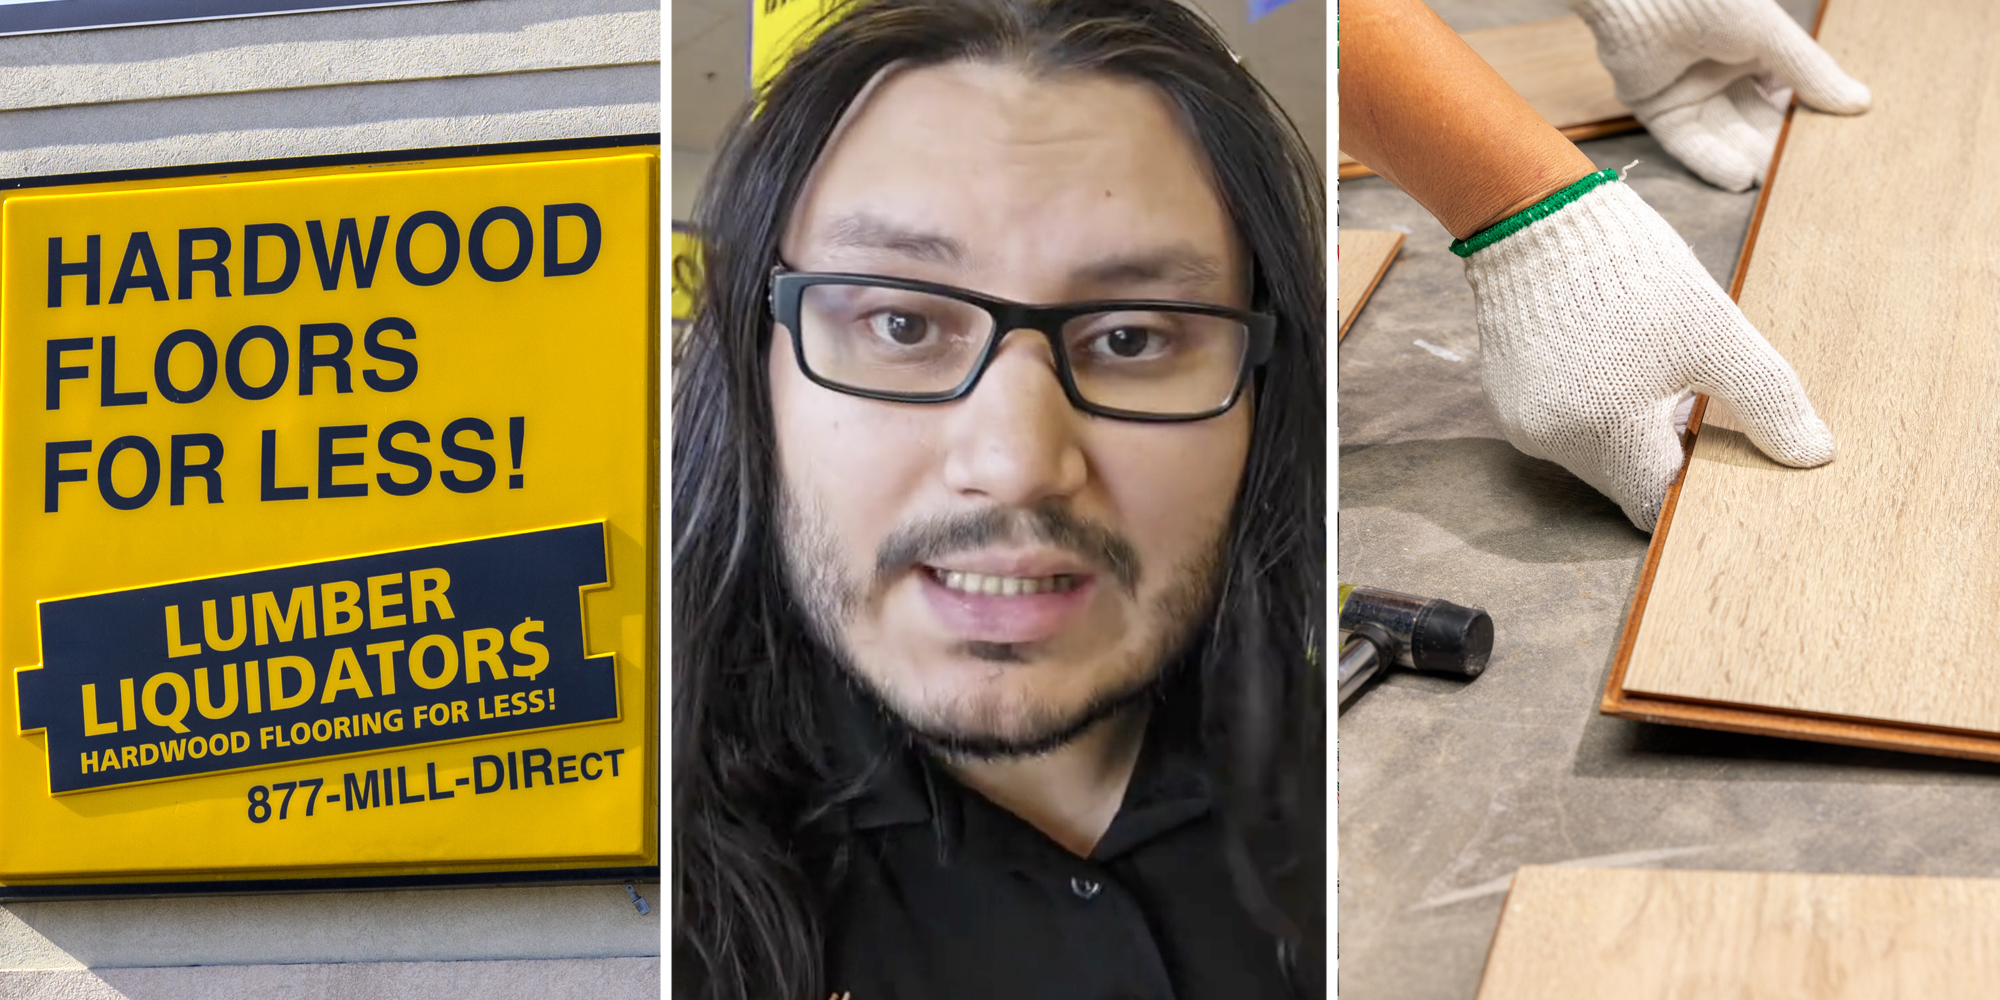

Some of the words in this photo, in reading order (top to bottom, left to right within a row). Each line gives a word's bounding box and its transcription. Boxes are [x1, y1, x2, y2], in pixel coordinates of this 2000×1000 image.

[47, 202, 602, 308] HARDWOOD
[45, 317, 419, 410] FLOORS
[44, 432, 225, 513] FOR
[260, 416, 526, 502] LESS!
[165, 567, 456, 660] LUMBER
[80, 730, 251, 774] HARDWOOD
[259, 709, 404, 750] FLOORING
[413, 701, 470, 730] FOR
[478, 687, 557, 718] LESS!
